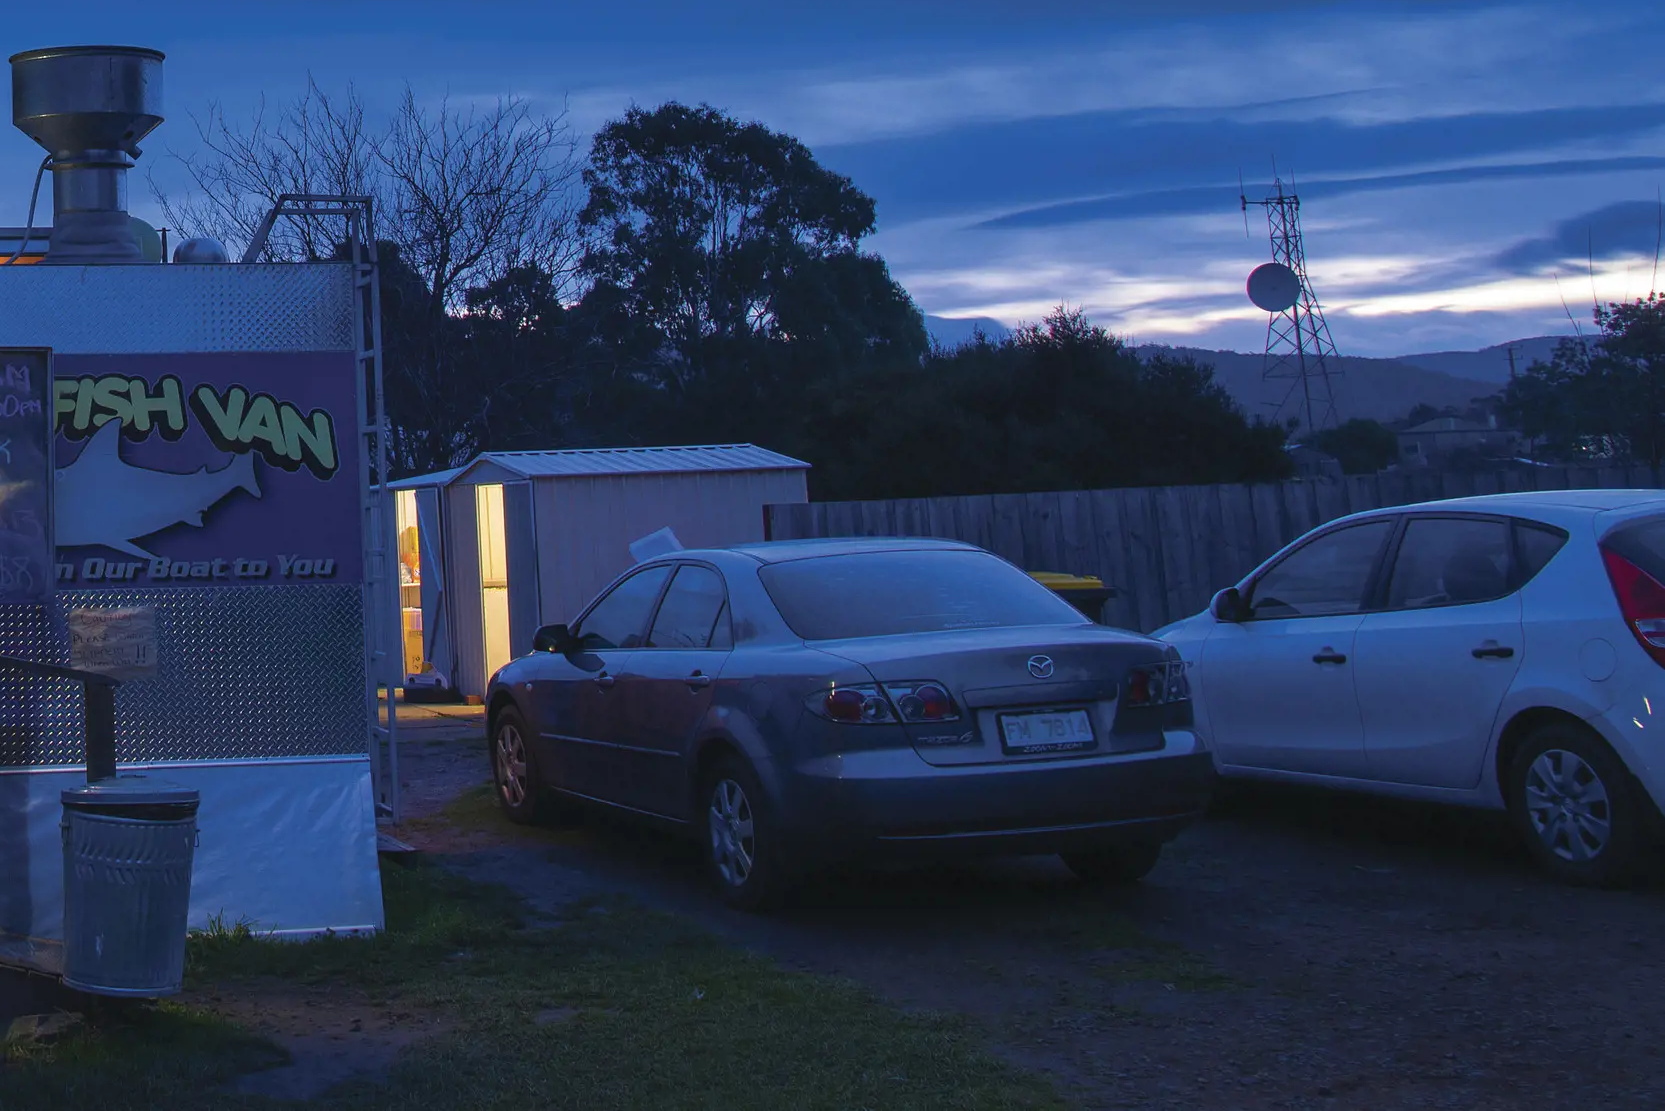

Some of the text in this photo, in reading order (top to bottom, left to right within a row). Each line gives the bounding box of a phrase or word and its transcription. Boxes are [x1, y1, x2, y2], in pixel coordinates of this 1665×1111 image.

[54, 374, 338, 474] FISH VAN
[81, 557, 144, 581] Our
[147, 555, 229, 581] Boat
[233, 555, 268, 580] to
[276, 553, 335, 578] You
